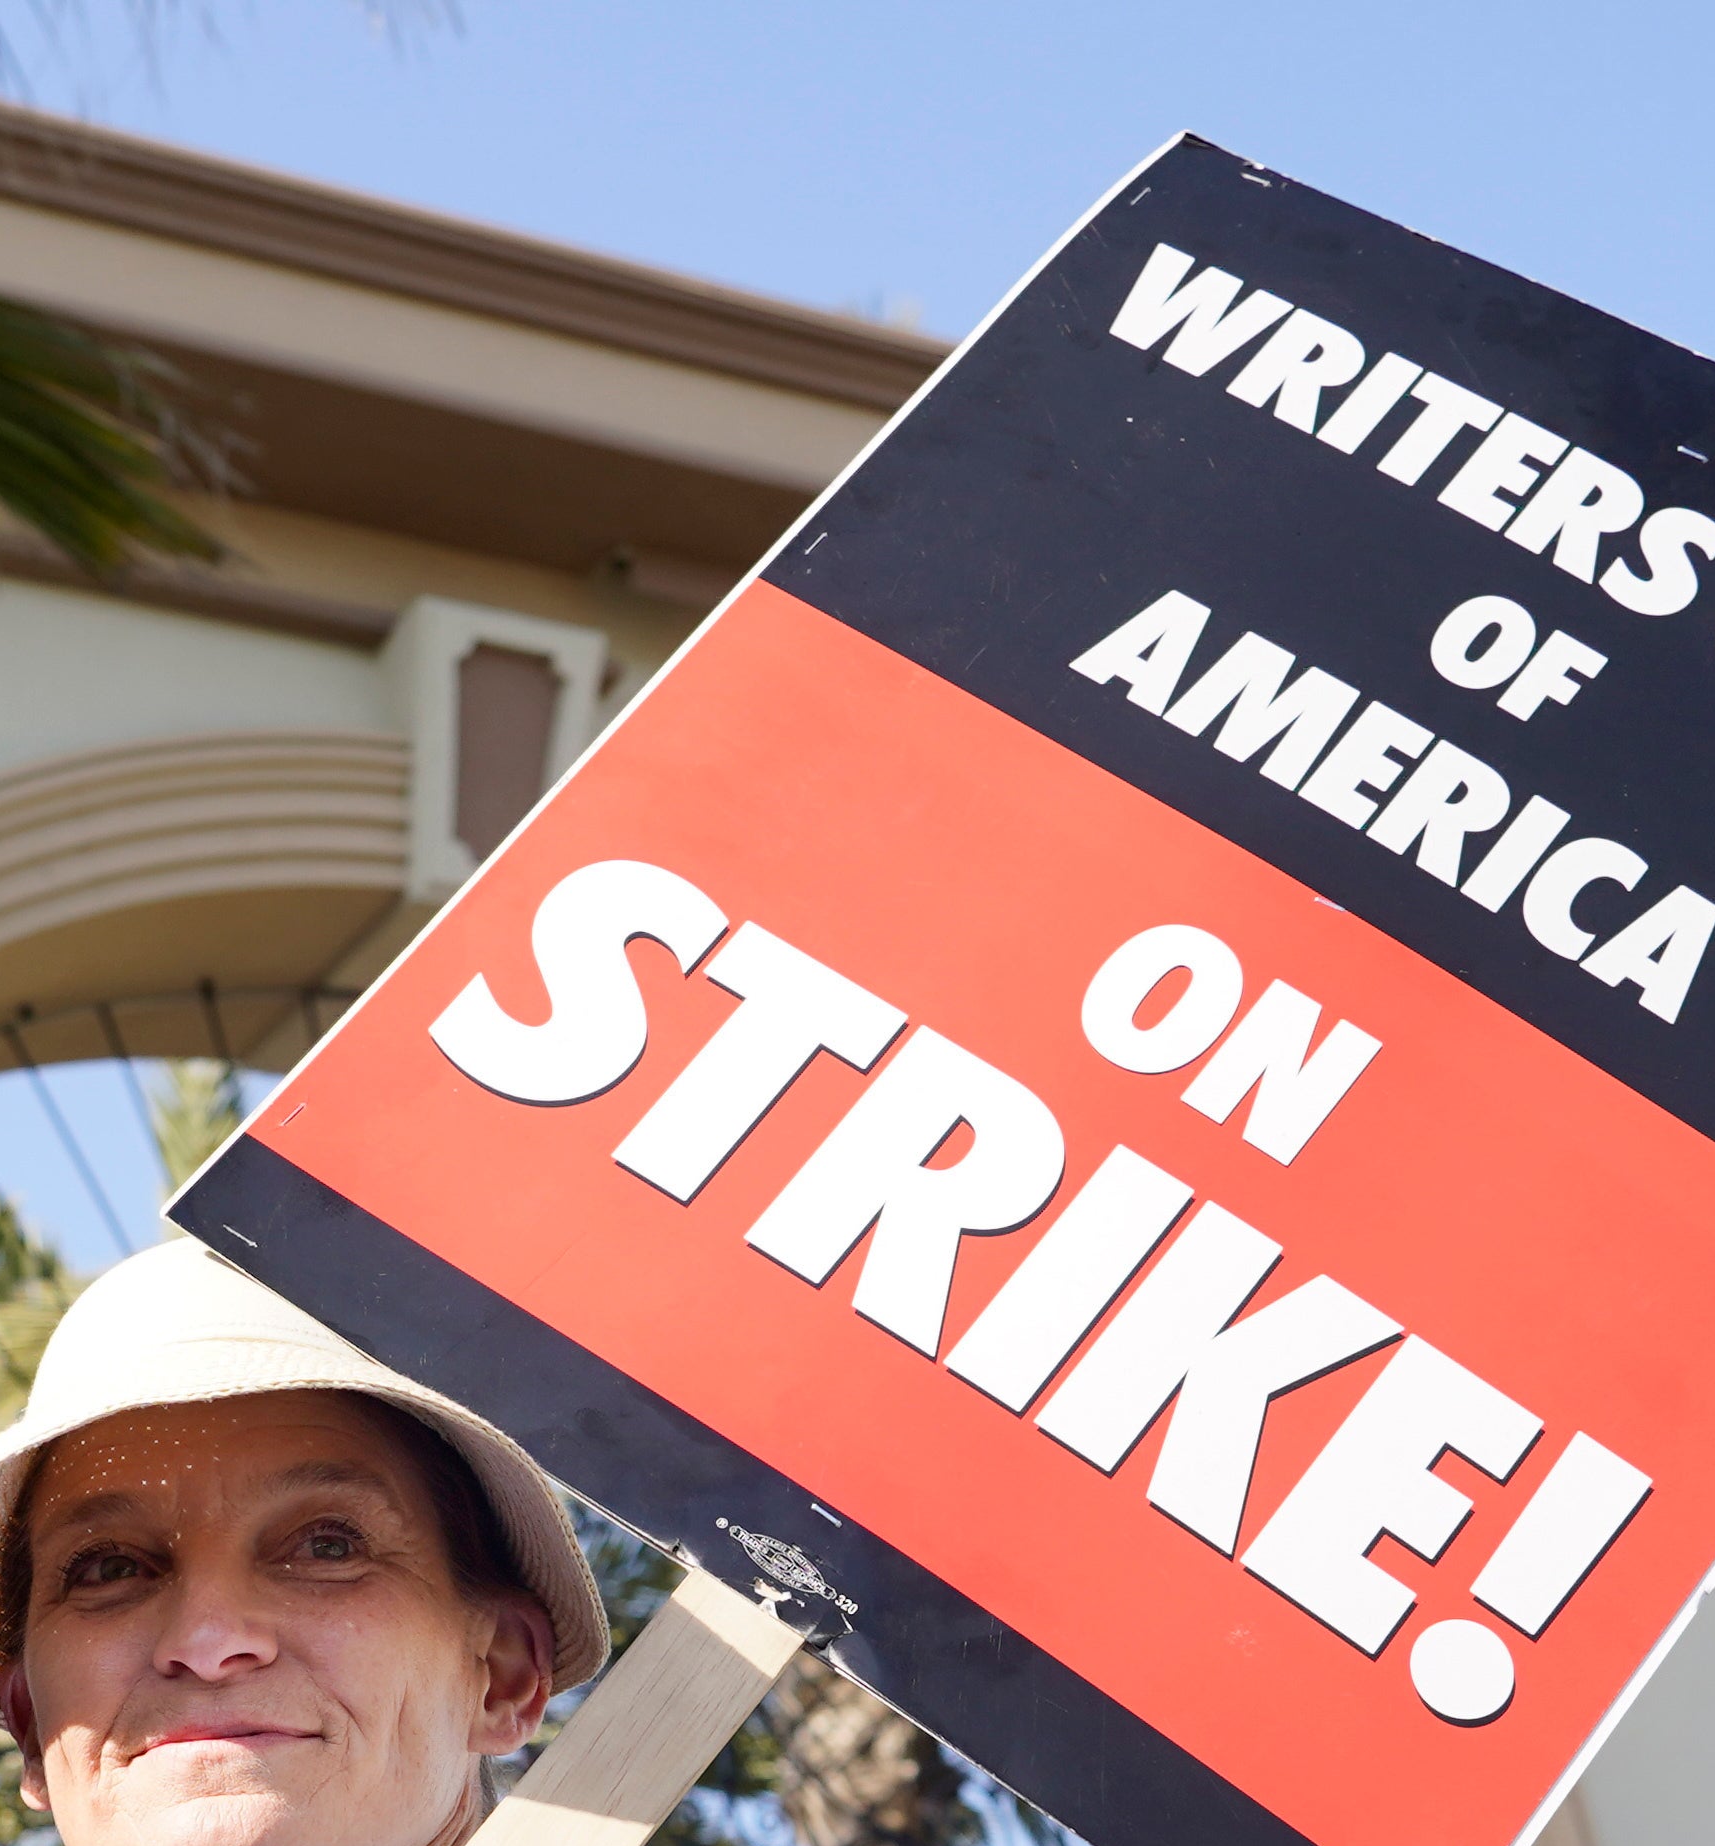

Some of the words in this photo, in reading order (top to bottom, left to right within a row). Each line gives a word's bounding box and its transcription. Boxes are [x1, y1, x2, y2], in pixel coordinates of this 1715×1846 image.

[1430, 595, 1609, 722] OF
[1080, 923, 1383, 1166] ON
[427, 859, 1654, 1726] STRIKE!
[834, 1594, 859, 1615] 320
